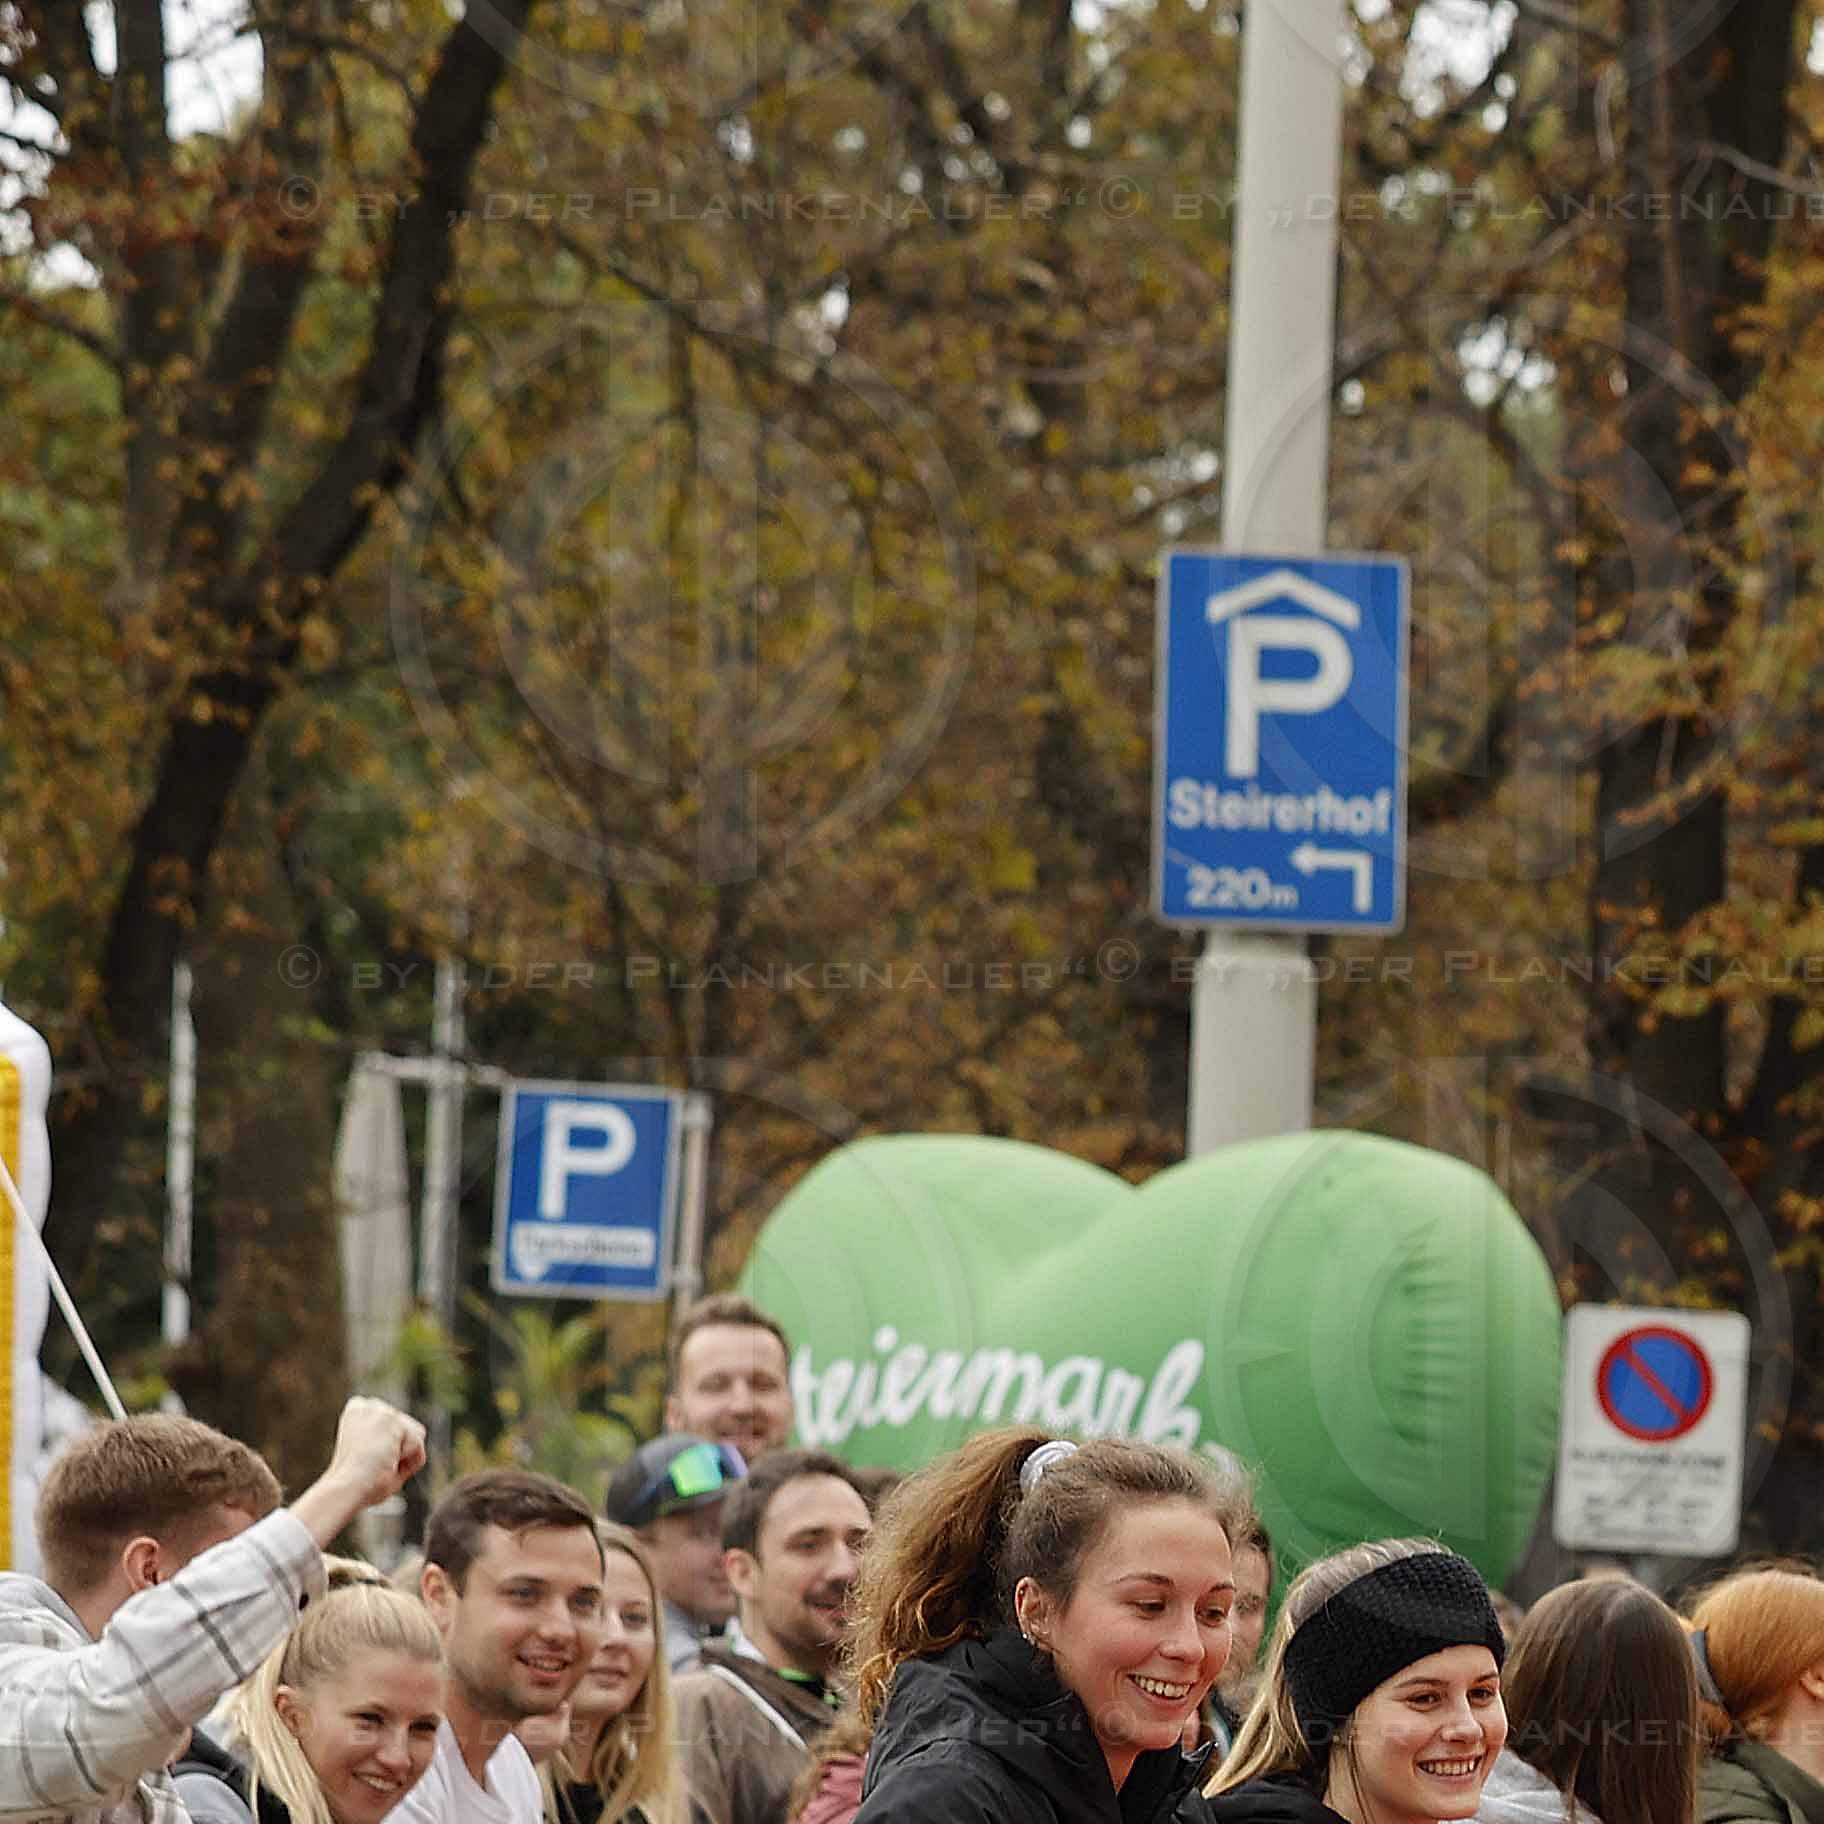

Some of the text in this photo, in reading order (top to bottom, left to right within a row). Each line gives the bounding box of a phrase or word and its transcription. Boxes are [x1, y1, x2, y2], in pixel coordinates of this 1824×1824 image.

[1226, 614, 1355, 780] P
[1168, 778, 1393, 836] Steirerhof
[1186, 864, 1300, 911] 220m
[537, 1101, 637, 1221] P
[789, 1324, 1212, 1450] teiermark
